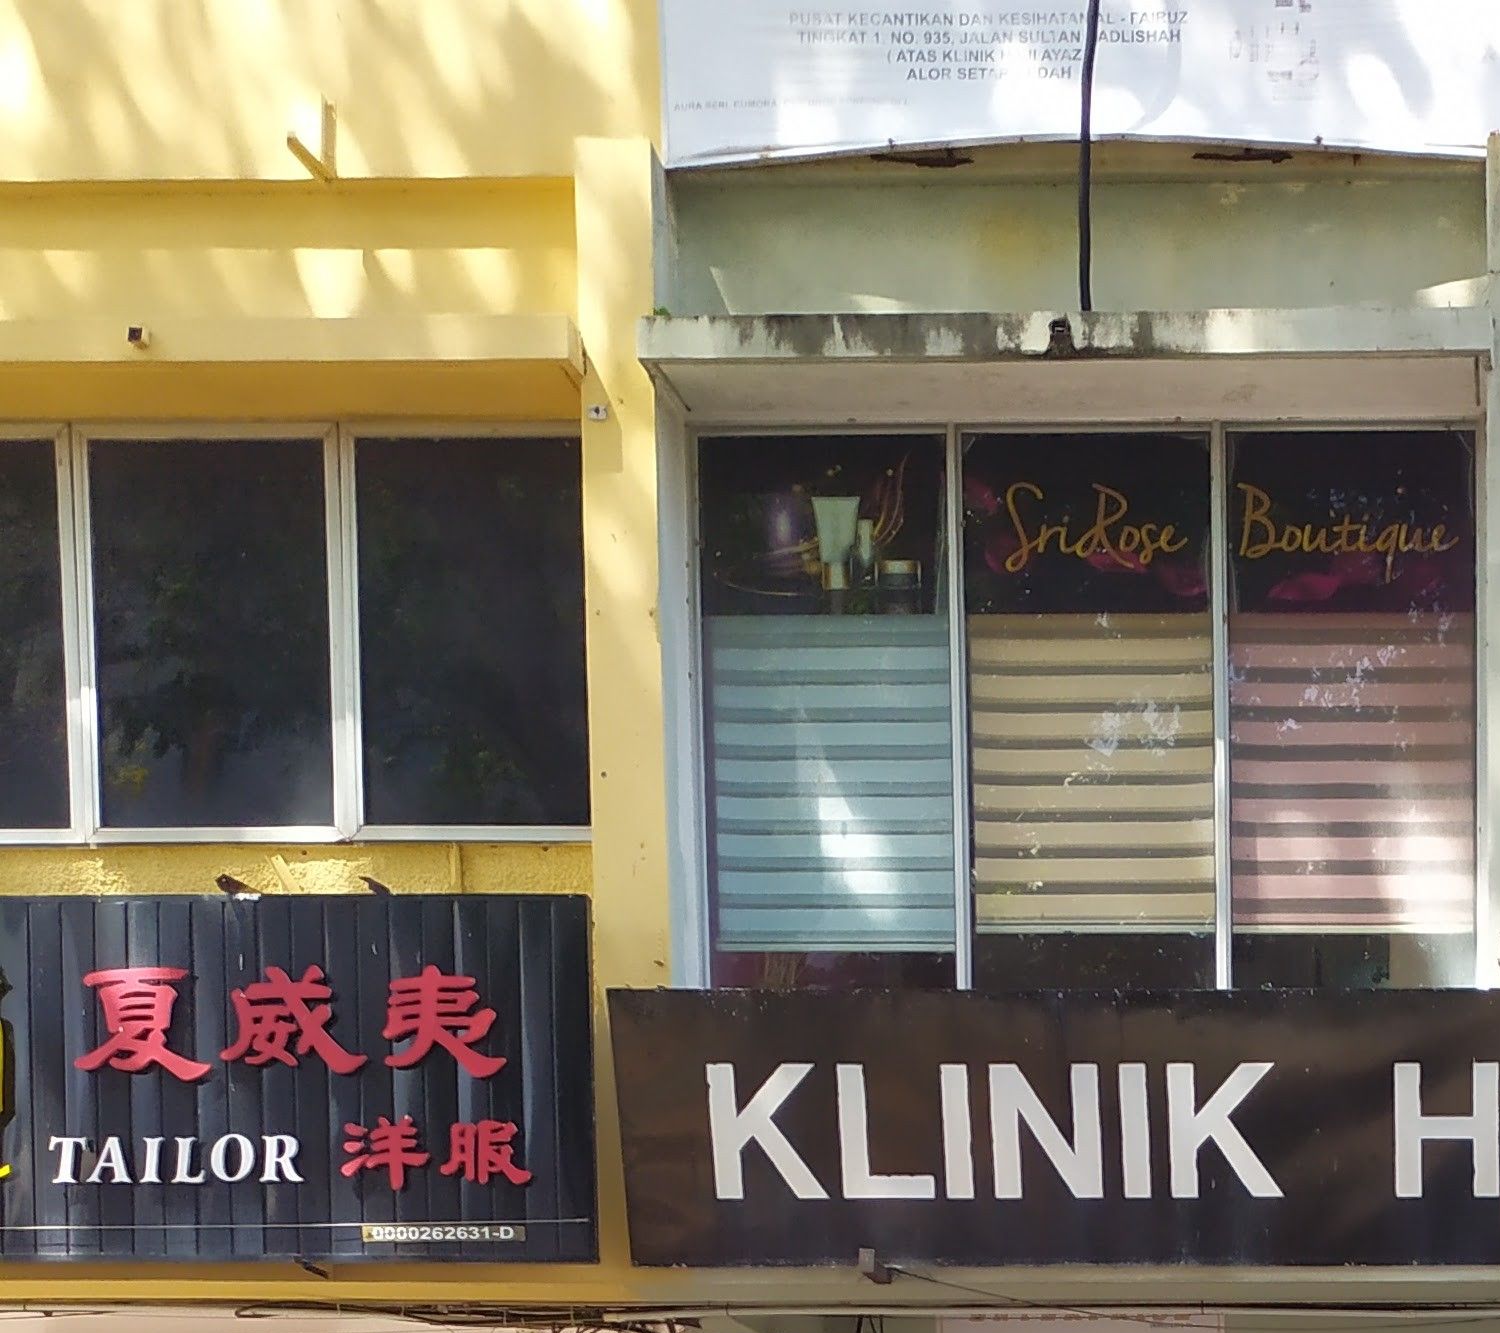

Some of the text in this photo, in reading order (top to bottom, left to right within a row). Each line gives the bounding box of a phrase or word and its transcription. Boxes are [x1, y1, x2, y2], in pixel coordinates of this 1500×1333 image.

[959, 13, 993, 26] DAN
[1093, 30, 1181, 43] ADLISHAH
[896, 51, 937, 63] ATAS
[942, 50, 995, 63] KLINIK
[907, 68, 951, 81] ALOR
[1236, 481, 1460, 584] Boutique
[74, 963, 509, 1082] 夏威夷
[340, 1115, 532, 1192] 洋服
[705, 1062, 1286, 1200] KLINIK
[48, 1133, 304, 1184] TAILOR
